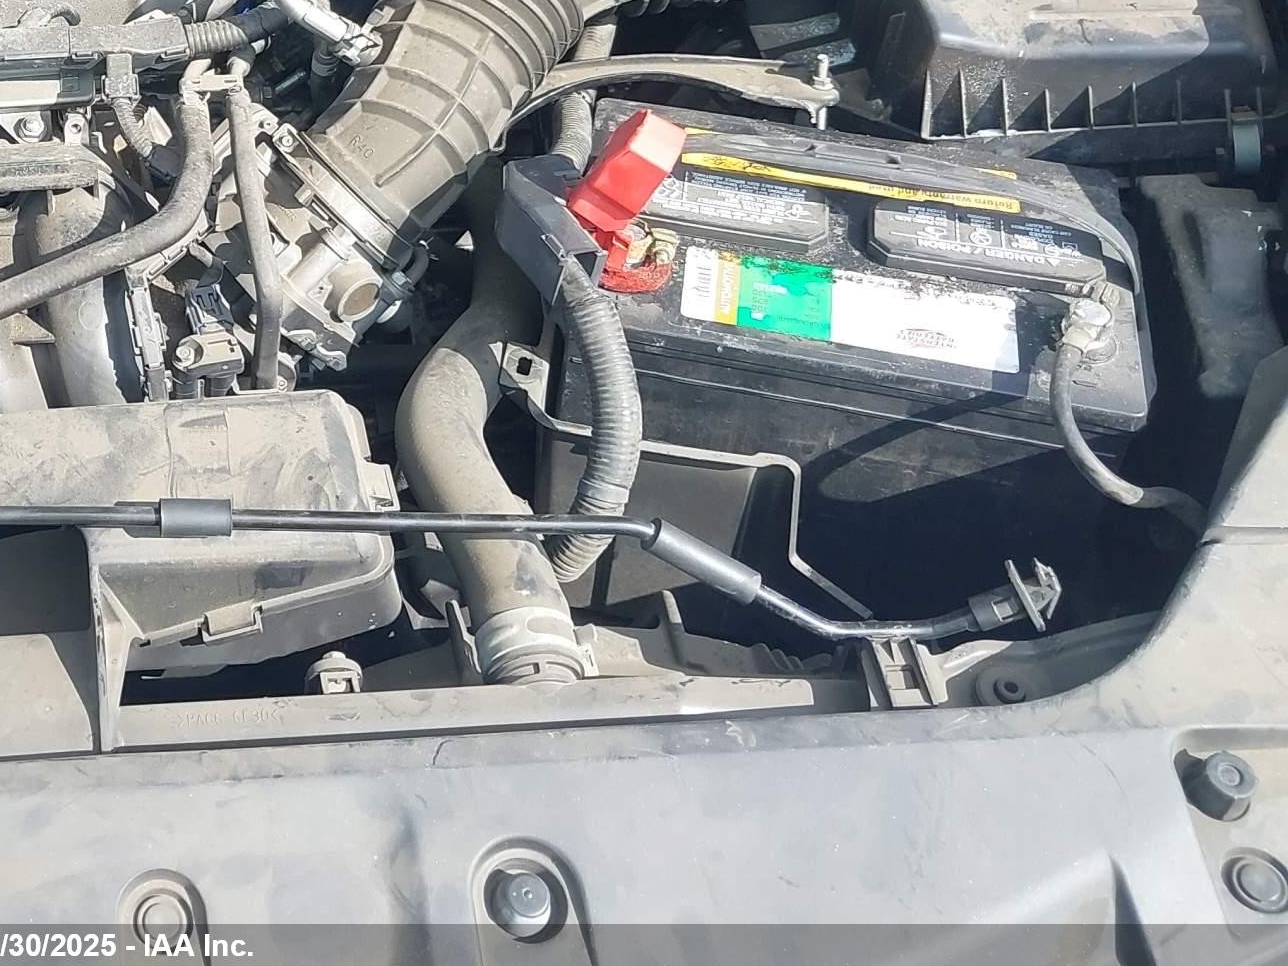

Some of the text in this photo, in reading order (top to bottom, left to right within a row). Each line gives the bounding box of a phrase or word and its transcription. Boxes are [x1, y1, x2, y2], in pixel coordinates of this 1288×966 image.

[975, 198, 1013, 210] Return
[917, 238, 973, 254] POISON
[983, 247, 1045, 264] DANGER
